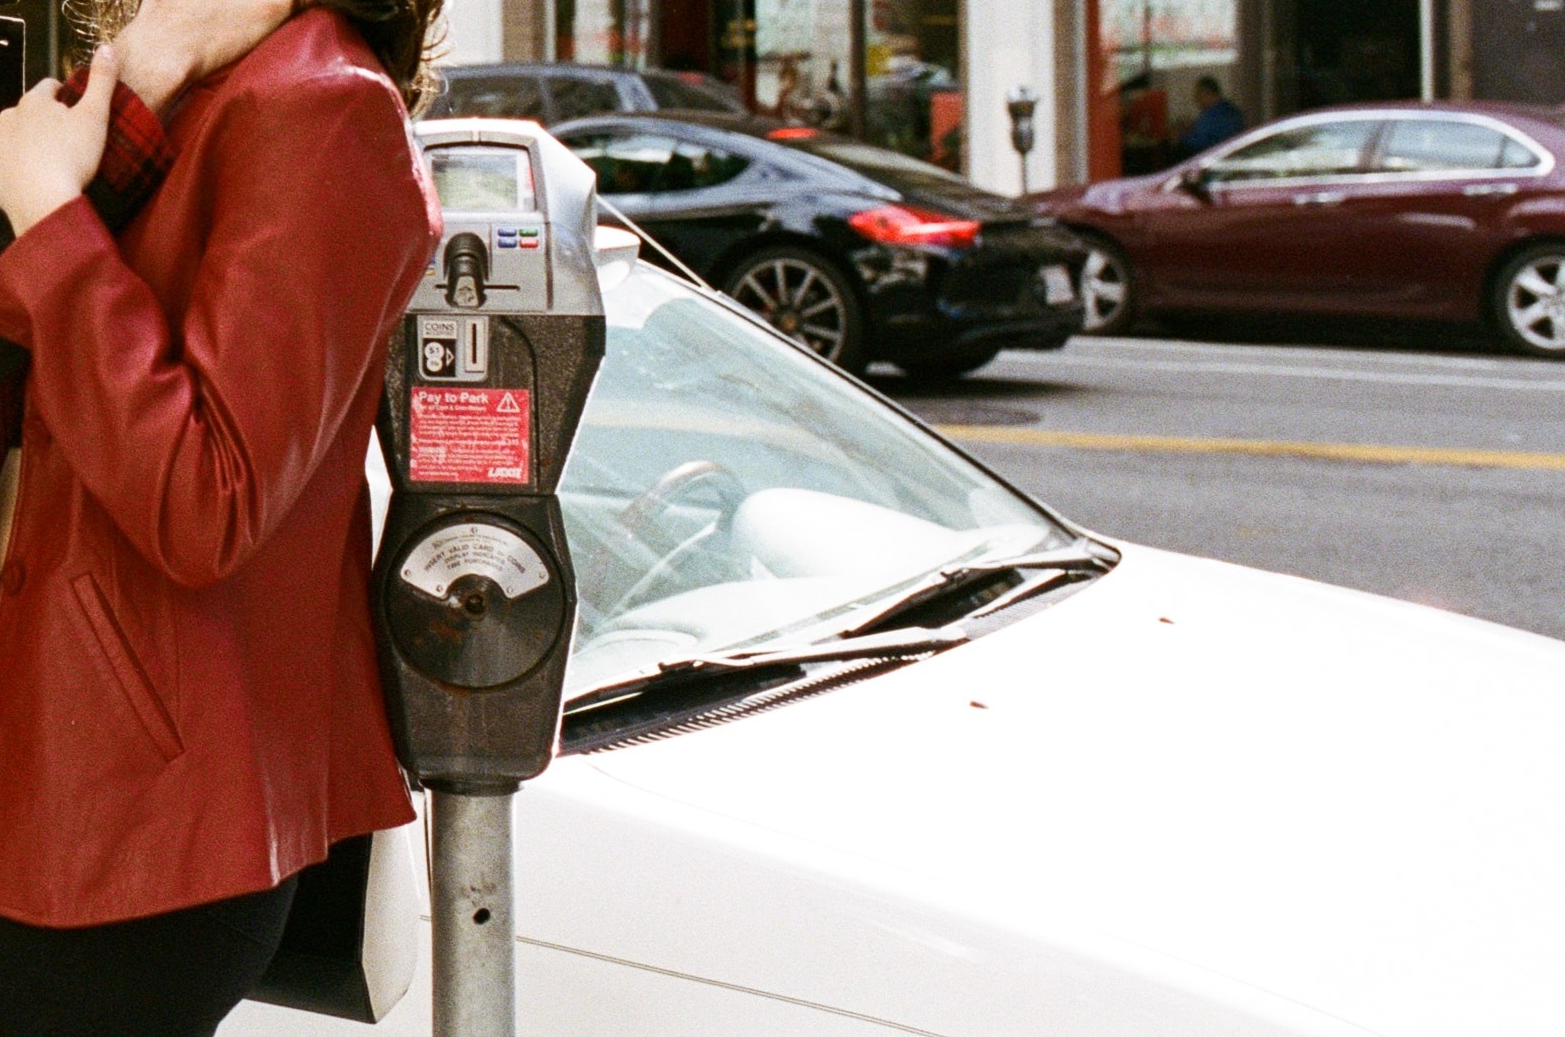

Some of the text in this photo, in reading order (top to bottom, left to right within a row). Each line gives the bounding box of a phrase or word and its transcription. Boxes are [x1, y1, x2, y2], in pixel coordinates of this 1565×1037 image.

[425, 323, 454, 331] COINS
[419, 391, 488, 405] Pay to Park
[448, 542, 470, 554] VALID
